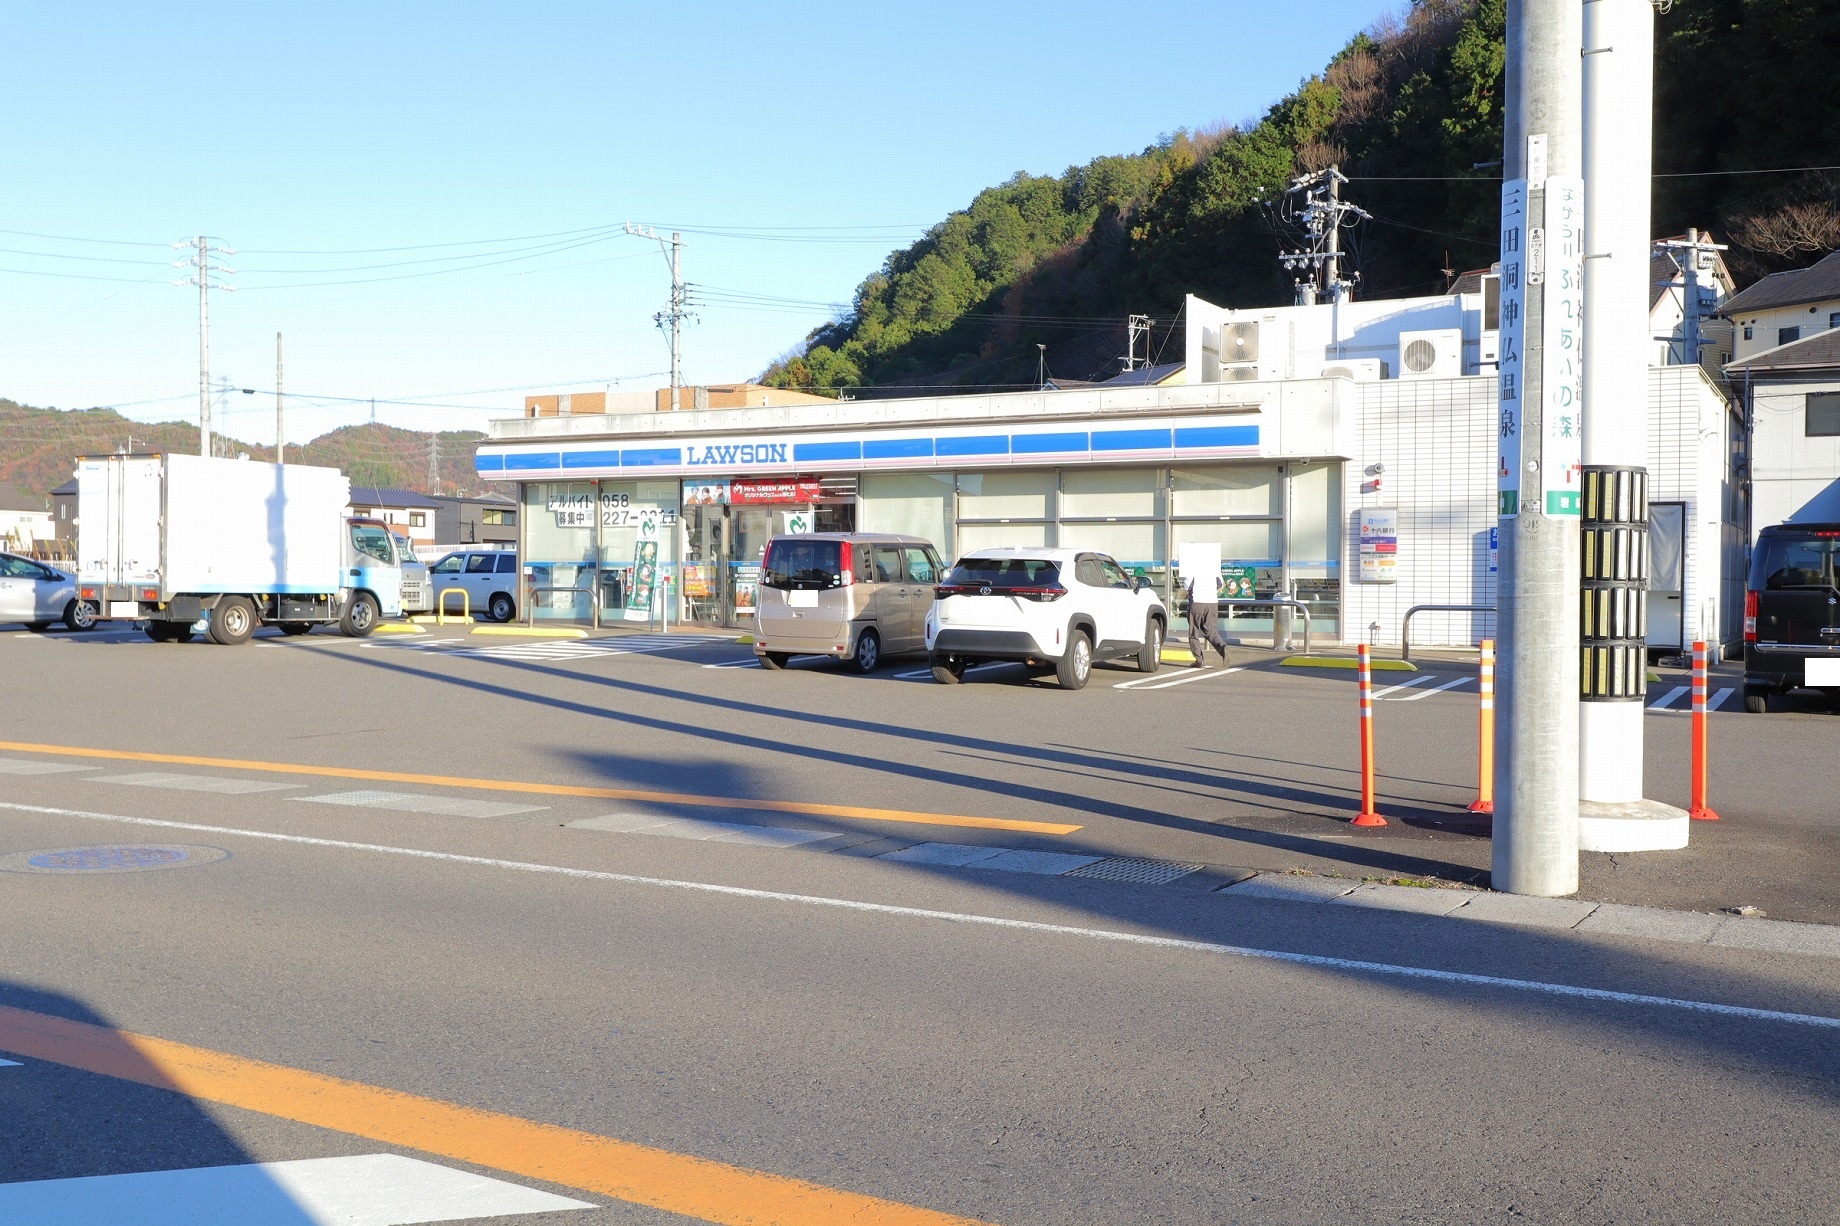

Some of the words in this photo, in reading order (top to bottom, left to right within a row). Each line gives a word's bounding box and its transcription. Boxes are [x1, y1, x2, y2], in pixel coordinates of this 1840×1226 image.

[1499, 187, 1521, 438] 三田洞神仏温泉
[687, 443, 787, 465] LAWSON
[549, 494, 594, 508] アルバイト
[602, 493, 629, 508] 058
[558, 511, 585, 525] 募集中
